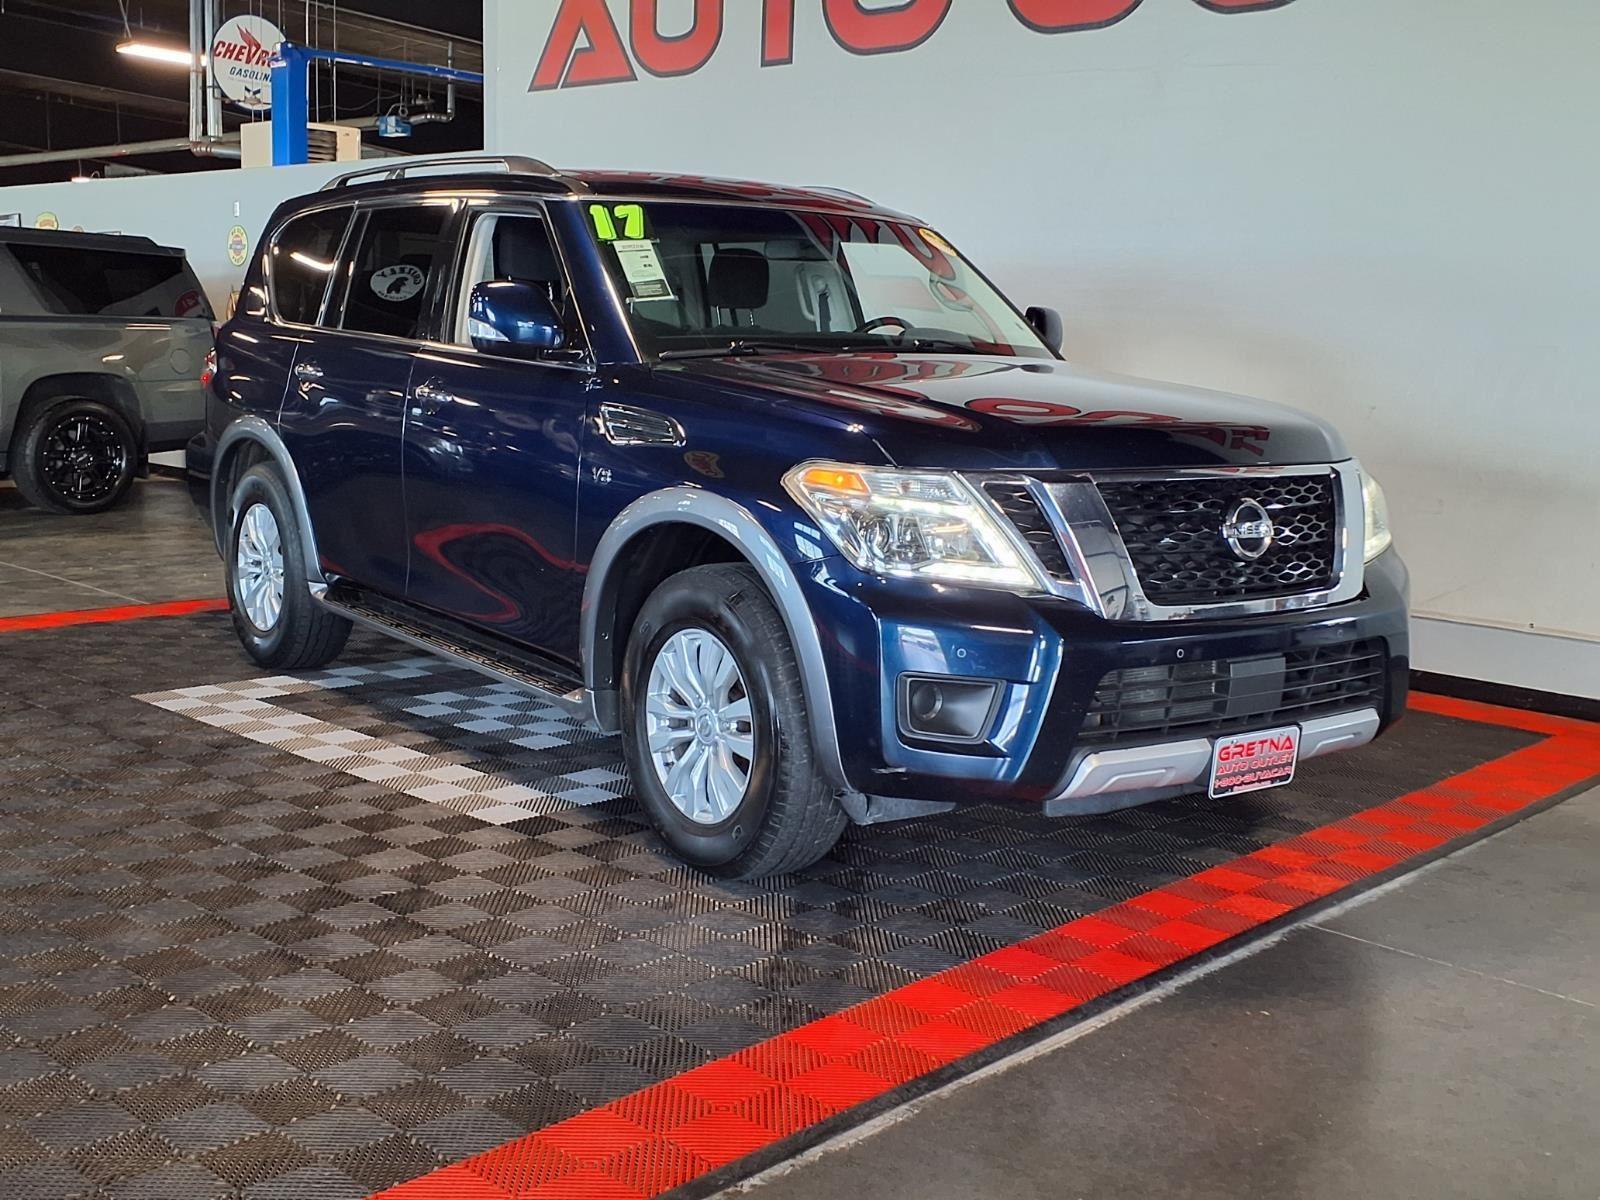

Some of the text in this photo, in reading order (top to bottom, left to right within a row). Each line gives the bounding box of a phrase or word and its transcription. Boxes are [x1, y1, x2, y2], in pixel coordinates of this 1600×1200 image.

[213, 33, 278, 67] CHEVR
[229, 66, 272, 82] GASOLIN
[589, 204, 645, 240] 17
[1218, 736, 1294, 762] GRETNA
[1217, 752, 1294, 775] AUTO OUTLET
